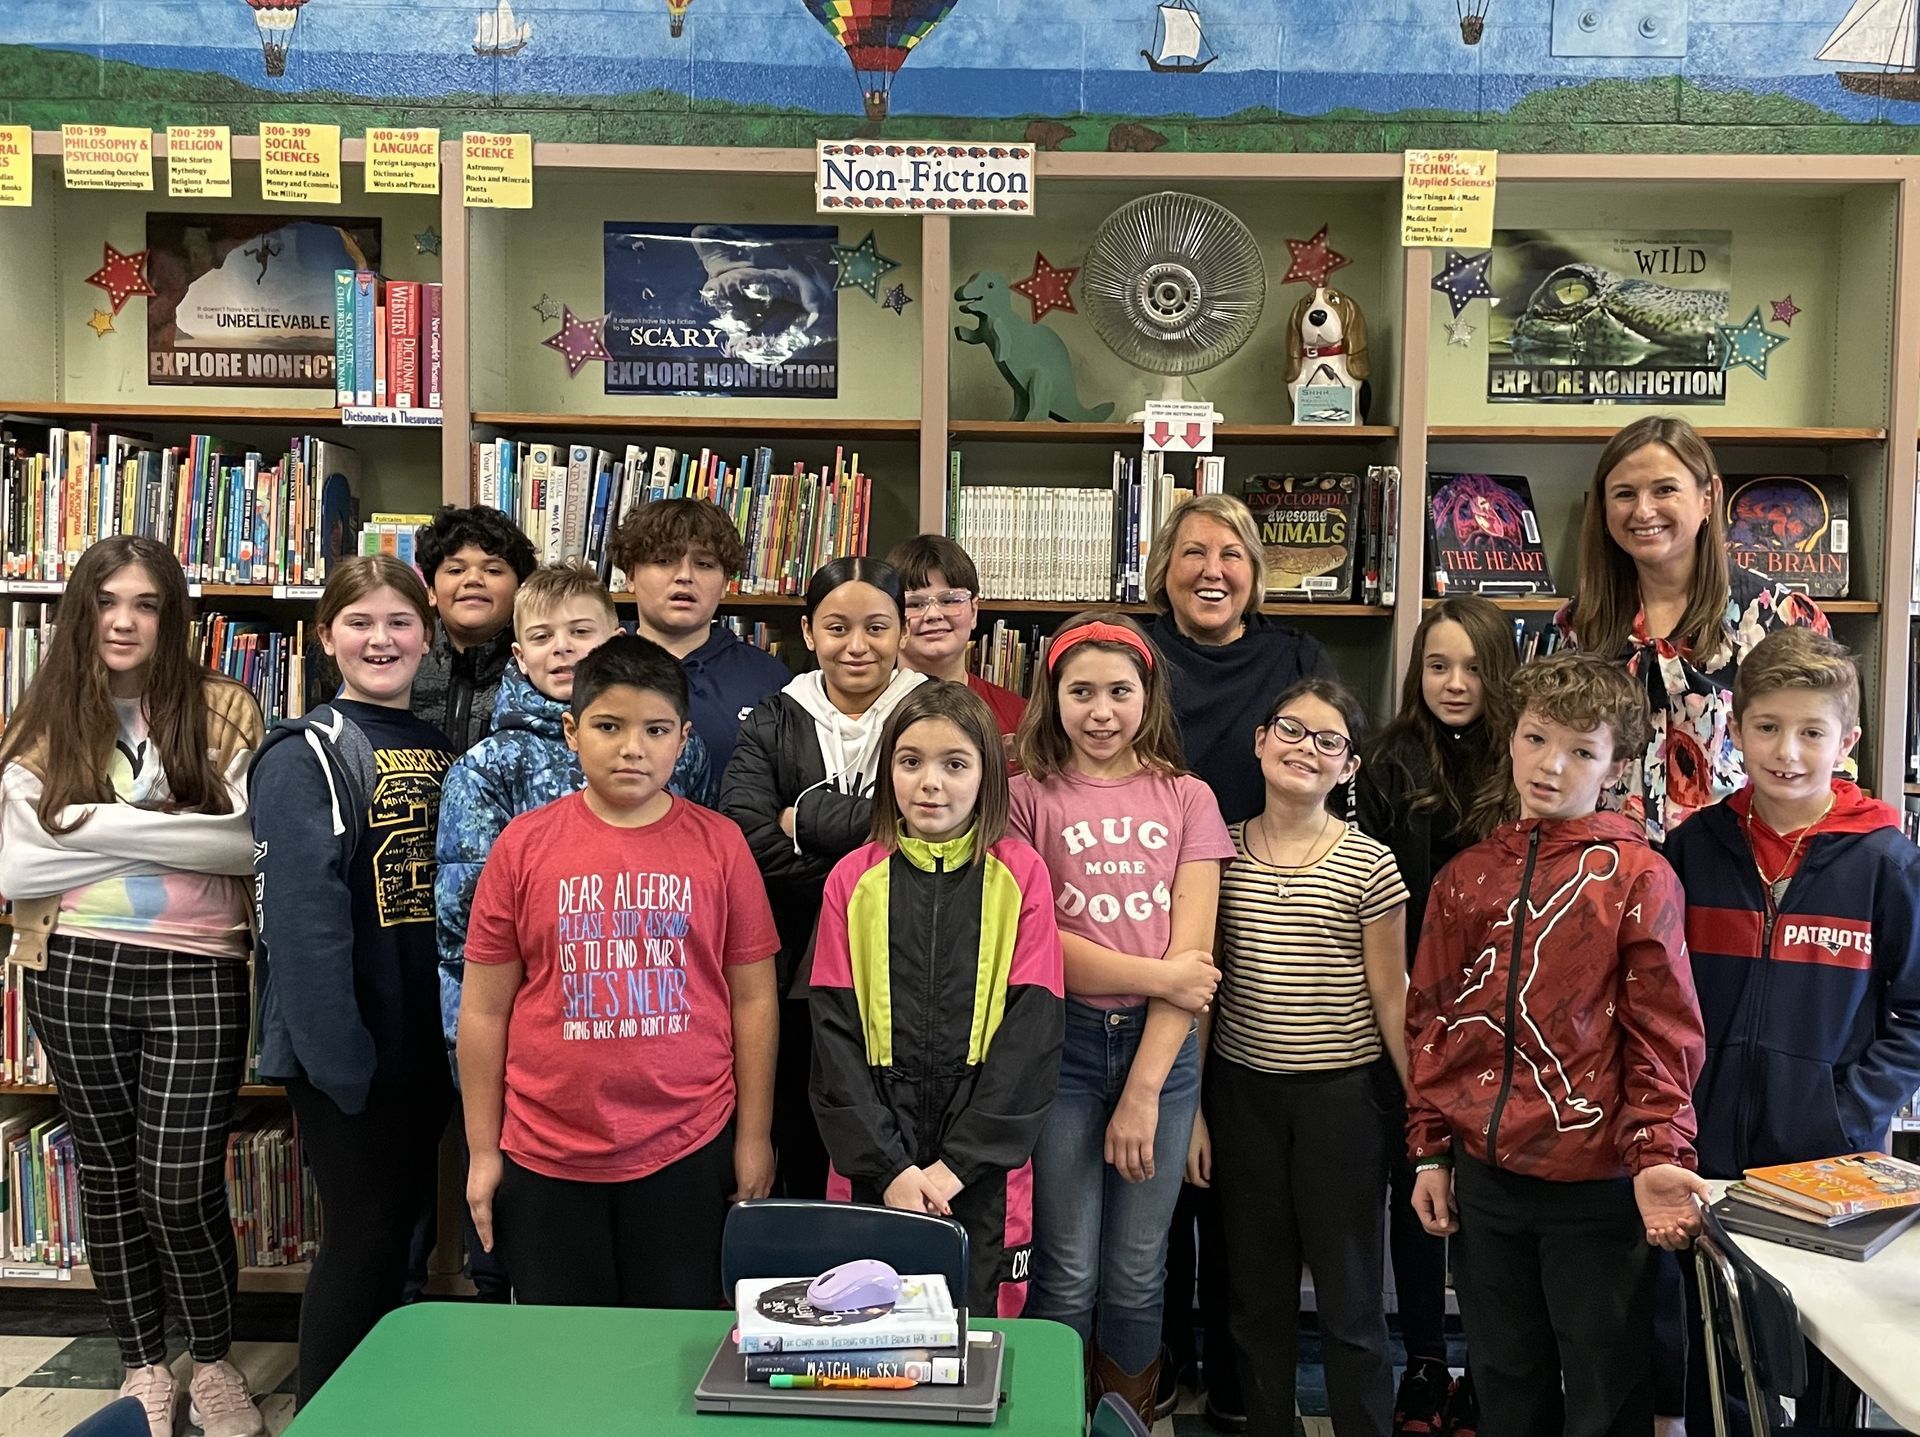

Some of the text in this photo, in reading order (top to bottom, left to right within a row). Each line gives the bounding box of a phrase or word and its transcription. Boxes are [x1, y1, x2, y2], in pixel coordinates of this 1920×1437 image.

[65, 127, 107, 137] 100-199
[171, 128, 216, 138] 200-299
[265, 126, 311, 137] 300-399
[373, 131, 419, 141] 400-499
[65, 139, 148, 150] PHILOSOPHY &
[171, 140, 223, 151] RELIGION
[265, 138, 307, 150] SOCIAL
[466, 135, 512, 146] 500-599
[373, 143, 434, 154] LANGUAGE
[466, 147, 514, 159] SCIENCE
[65, 151, 138, 163] PSYCHOLOGY
[171, 156, 187, 164] Bible
[265, 151, 320, 163] SCIENCES
[373, 159, 436, 169] Foreign Languages
[466, 164, 504, 173] Astronomy
[66, 168, 150, 177] Understanding Ourselves
[172, 167, 207, 176] Mythology
[266, 168, 293, 177] Folklore
[308, 170, 330, 178] Fables
[373, 170, 414, 178] Dictionaries
[823, 159, 1029, 193] Non-Fiction
[67, 179, 144, 189] Mysterious Happenings
[266, 179, 339, 189] Money and Economics
[409, 181, 436, 189] Phrases
[501, 176, 531, 184] Minerals
[1408, 177, 1495, 188] (Applied Sciences)
[280, 190, 308, 200] Military
[466, 185, 487, 193] Plants
[1634, 246, 1707, 275] WILD
[217, 313, 331, 330] UNBELIEVABLE
[432, 317, 441, 332] New
[345, 312, 354, 368] SCHOLASTIC
[391, 285, 416, 393] WEBSTER'S DICTIONARY
[630, 326, 721, 348] SCARY
[151, 351, 336, 379] EXPLORE NONFICT
[431, 362, 441, 393] Thesaurus
[607, 361, 835, 389] EXPLORE NONFICTION
[1491, 370, 1723, 396] EXPLORE NONFICTION
[344, 409, 389, 423] Dictionaries
[391, 411, 397, 423] &
[483, 451, 493, 501] Your World
[1247, 493, 1350, 506] ENCYCLOPEDIA
[1268, 510, 1328, 523] awesome
[1261, 523, 1345, 544] NIMALS
[1442, 551, 1544, 571] THE HEART
[1735, 552, 1842, 574] HE BRAIN
[1061, 816, 1169, 855] HUG
[1085, 861, 1146, 875] MORE
[558, 871, 693, 915] DEAR ALGEBRA
[1055, 880, 1171, 923] DOGS
[558, 910, 690, 942] PLEASE STOP ASKING
[1784, 924, 1872, 955] PATRIOTS
[559, 938, 687, 973] US TO FIND YOUR X
[562, 968, 692, 1019] SHE'S NEVER
[563, 1013, 691, 1041] COMING BACK AND DON'T ASK Y
[807, 1361, 899, 1378] WATCH THE SKY
